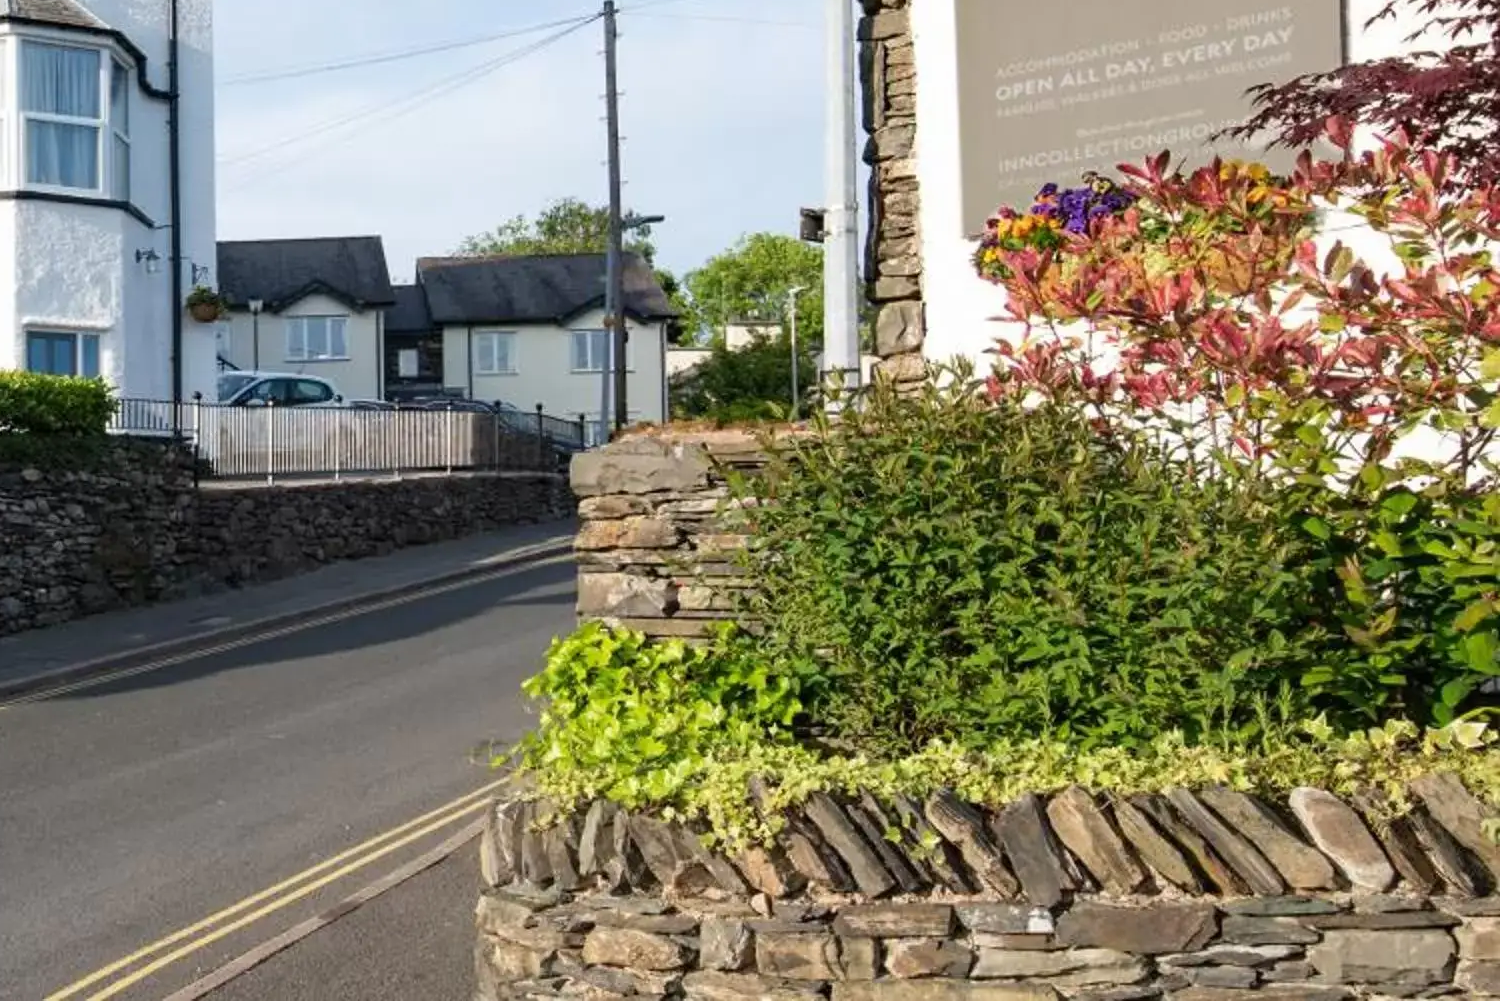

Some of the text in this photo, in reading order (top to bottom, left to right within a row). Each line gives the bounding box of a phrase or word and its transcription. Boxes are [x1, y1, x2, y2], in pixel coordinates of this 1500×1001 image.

[994, 5, 1293, 79] ACCOMMODATION FOOD DRINKS
[996, 24, 1295, 101] OPEN ALL DAY, EVERY DAY
[999, 120, 1216, 174] INNCOLLECTIONGRO
